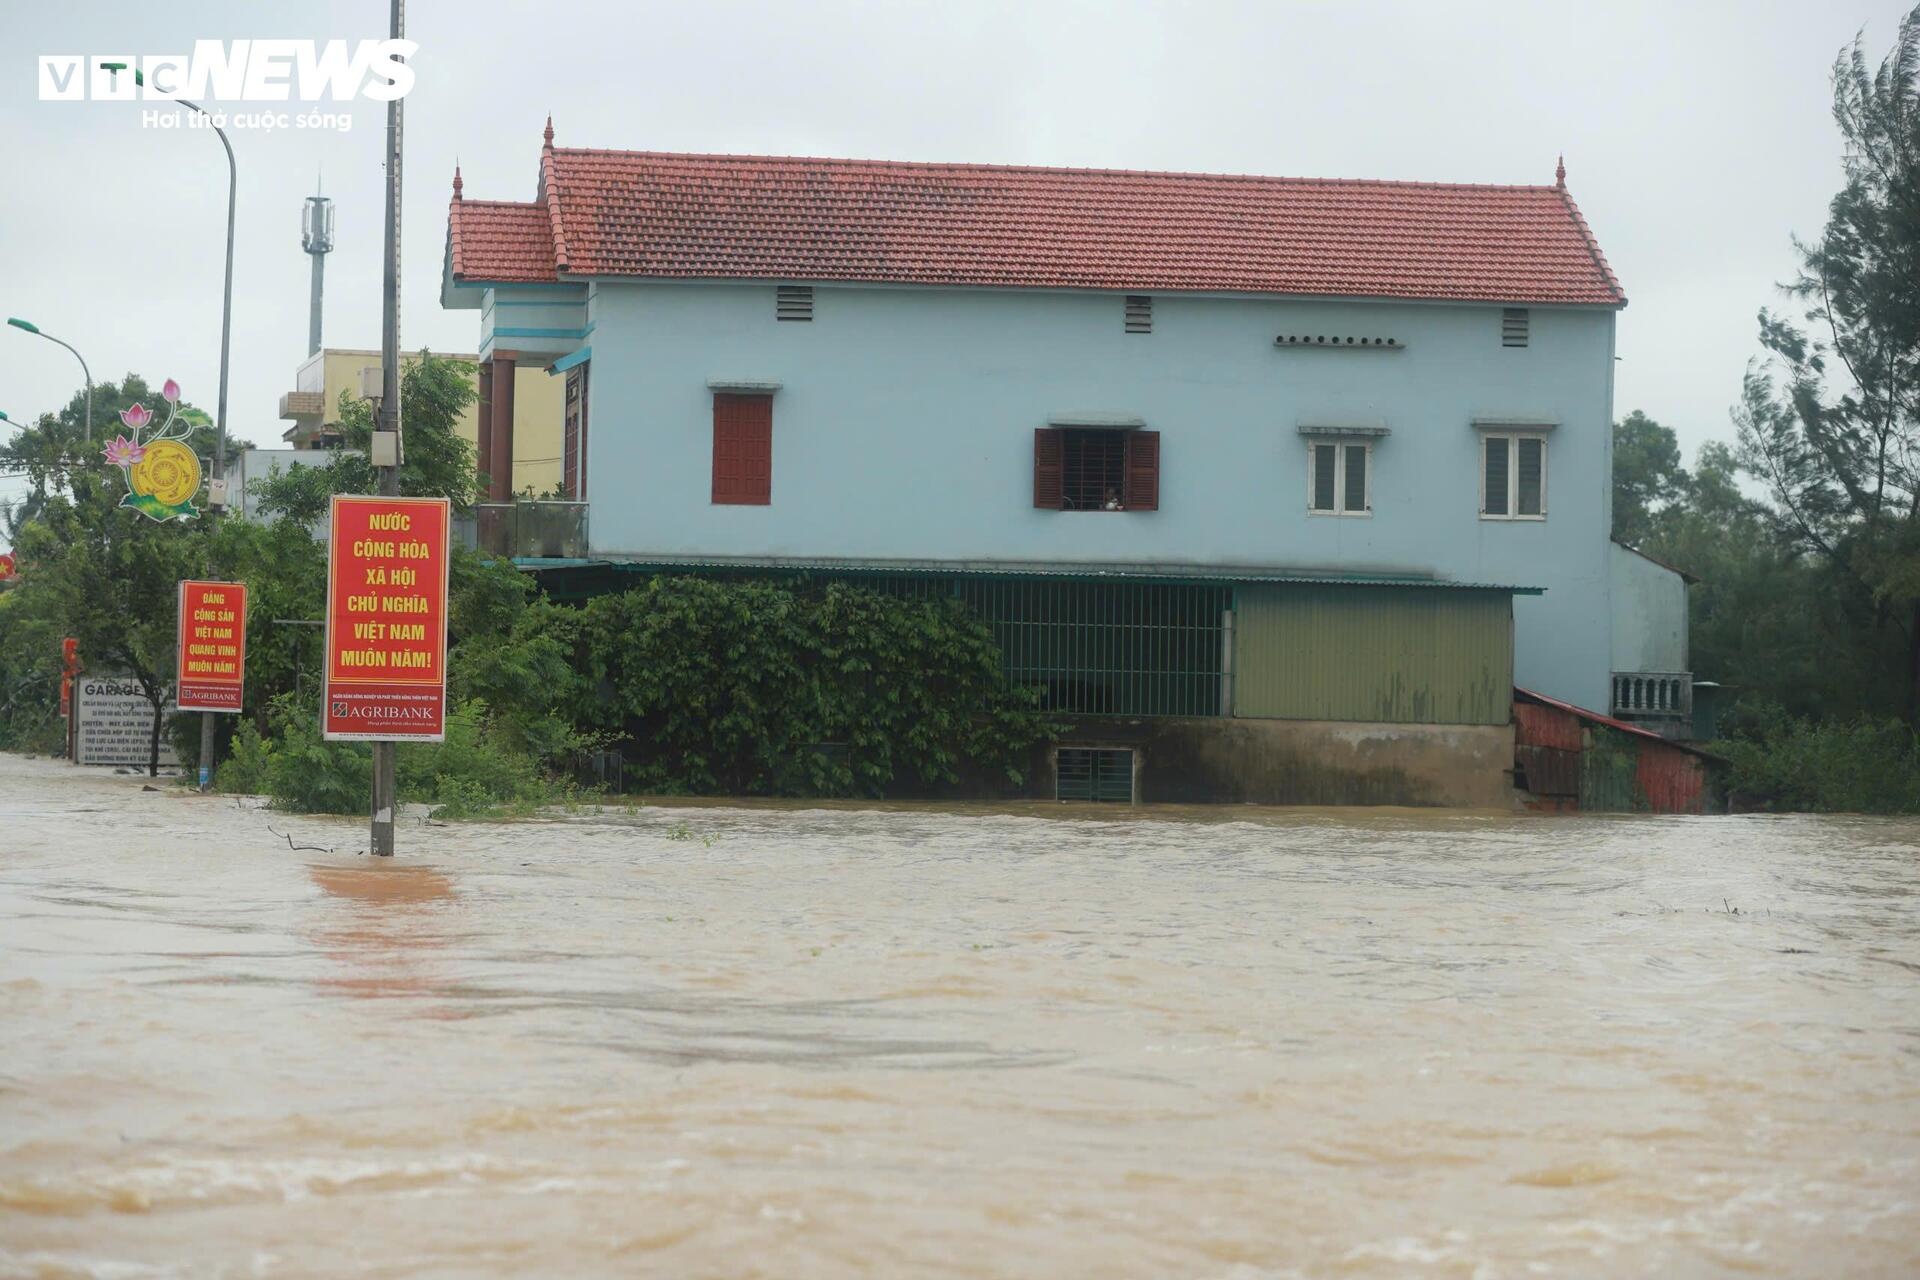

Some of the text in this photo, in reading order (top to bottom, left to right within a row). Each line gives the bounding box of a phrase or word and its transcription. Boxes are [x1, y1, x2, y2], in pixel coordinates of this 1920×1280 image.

[369, 512, 411, 532] NƯỚC
[353, 538, 430, 561] CỘNG HÒA
[365, 565, 416, 589] XÃ HỘI
[202, 591, 225, 605] ĐẢNG
[347, 591, 429, 614] CHỦ NGHĨA
[194, 608, 235, 623] CỘNG SẢN
[194, 625, 233, 640] VIỆT NAM
[354, 620, 425, 643] VIỆT NAM
[189, 644, 237, 657] QUANG VINH
[340, 648, 432, 668] MUÔN NĂM!
[188, 659, 236, 674] MUÔN NĂM!
[84, 684, 141, 696] GARAGE
[191, 689, 237, 701] AGRIBANK
[349, 706, 433, 719] AGRIBANK
